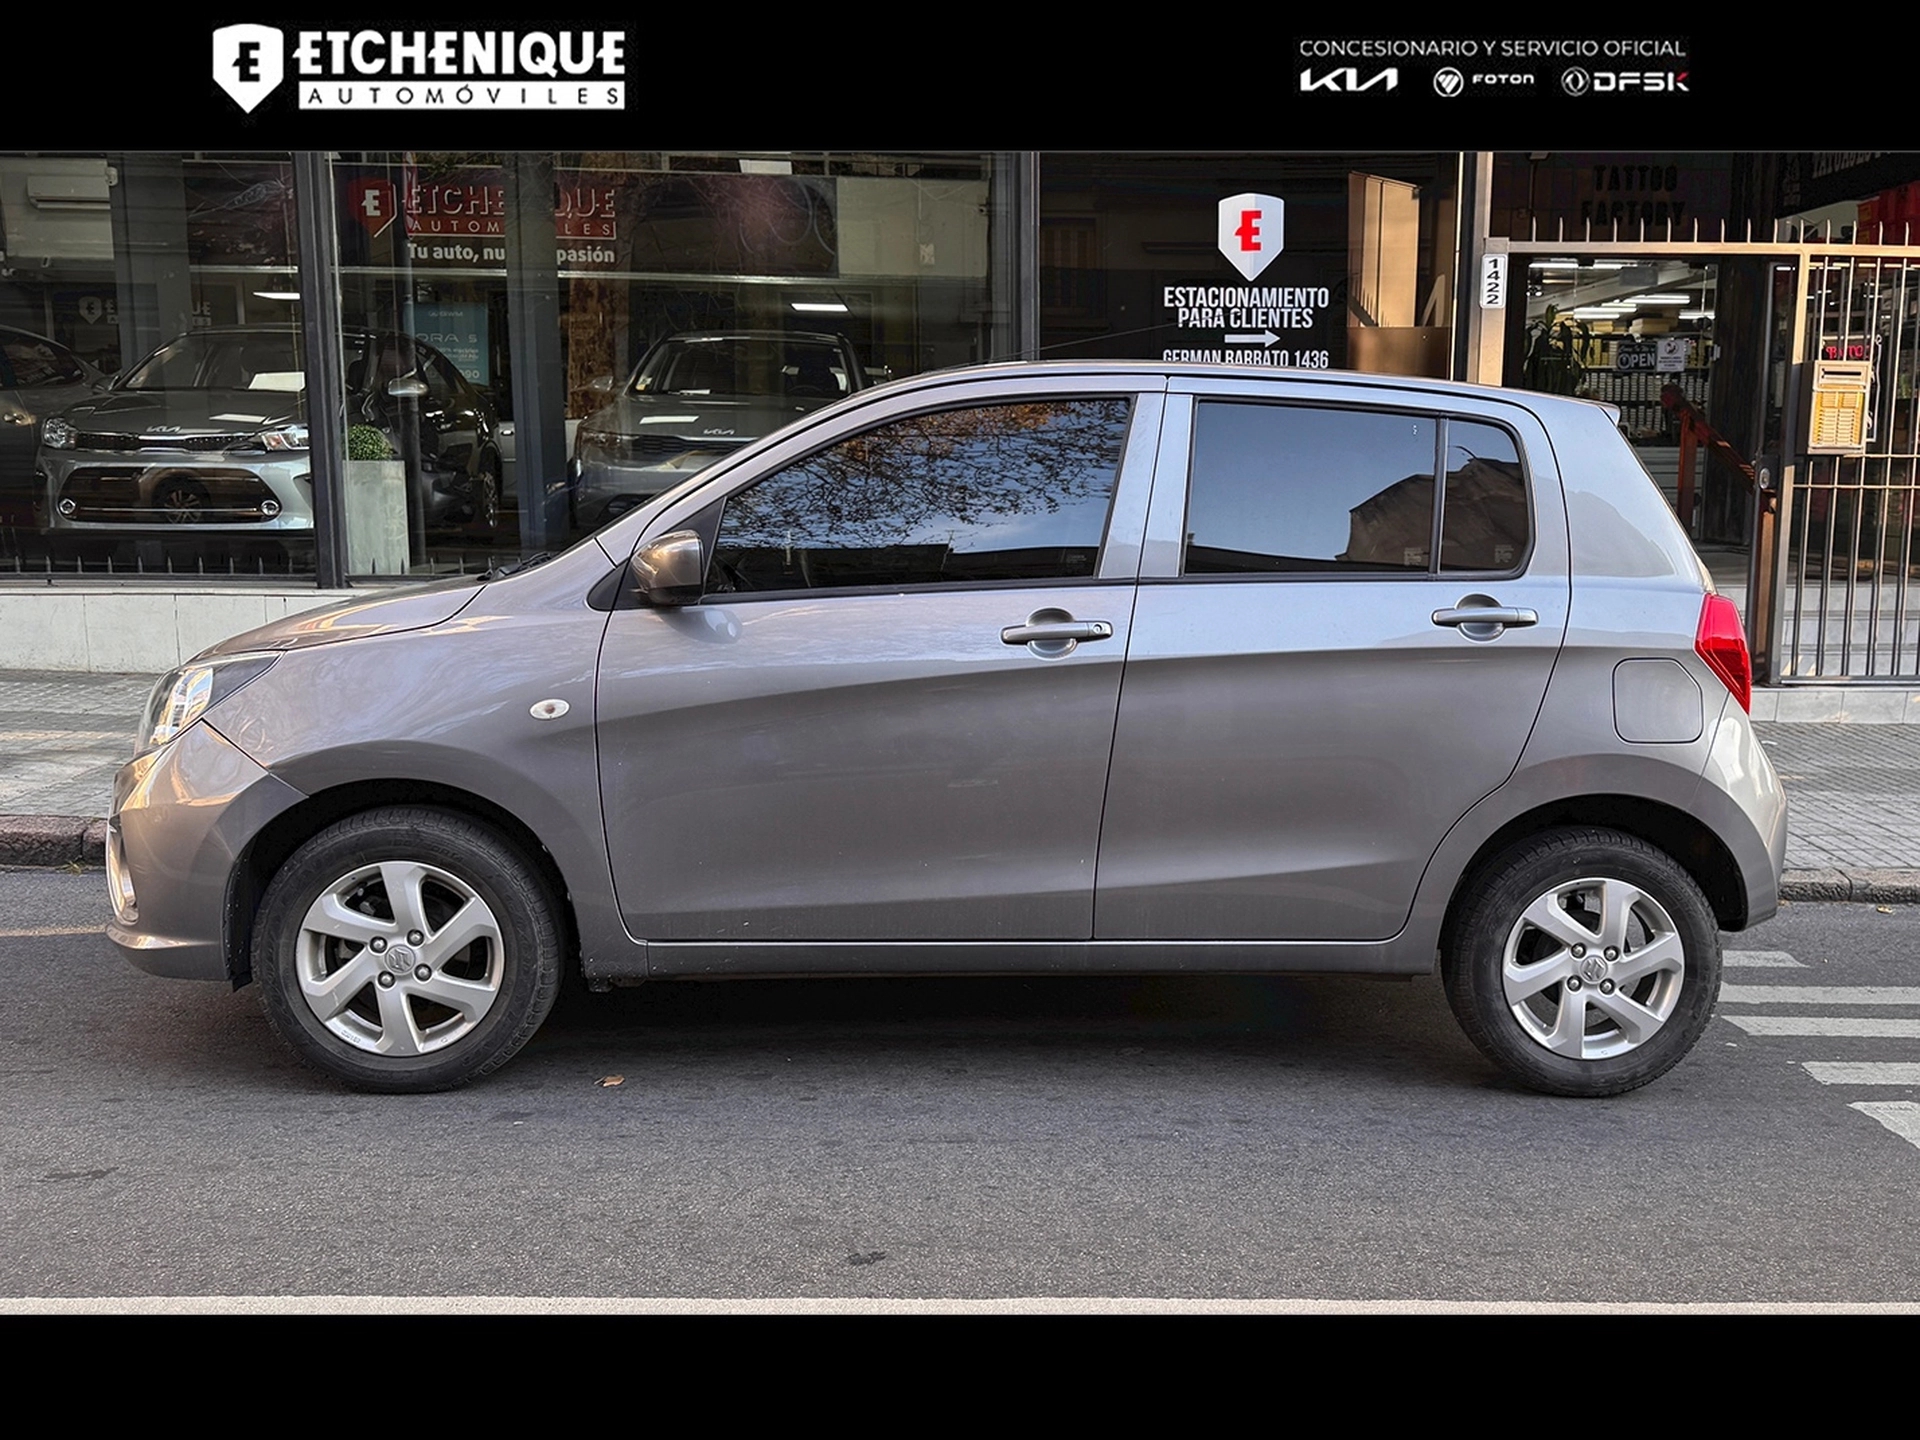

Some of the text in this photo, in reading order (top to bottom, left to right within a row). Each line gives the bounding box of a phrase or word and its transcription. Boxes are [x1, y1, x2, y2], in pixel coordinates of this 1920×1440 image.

[1594, 165, 1677, 191] TATTOO
[1581, 201, 1686, 225] FACTORY
[408, 243, 428, 259] Tu
[433, 245, 480, 263] auto,
[556, 245, 616, 264] pasión
[1486, 258, 1501, 305] 1422
[1164, 287, 1329, 308] ESTACIONAMIENTO
[1178, 308, 1313, 328] PARA CLIENTES
[415, 333, 459, 343] ORA
[1225, 350, 1289, 367] BARBATO
[1294, 350, 1329, 369] 1436
[1617, 353, 1656, 369] OPEN
